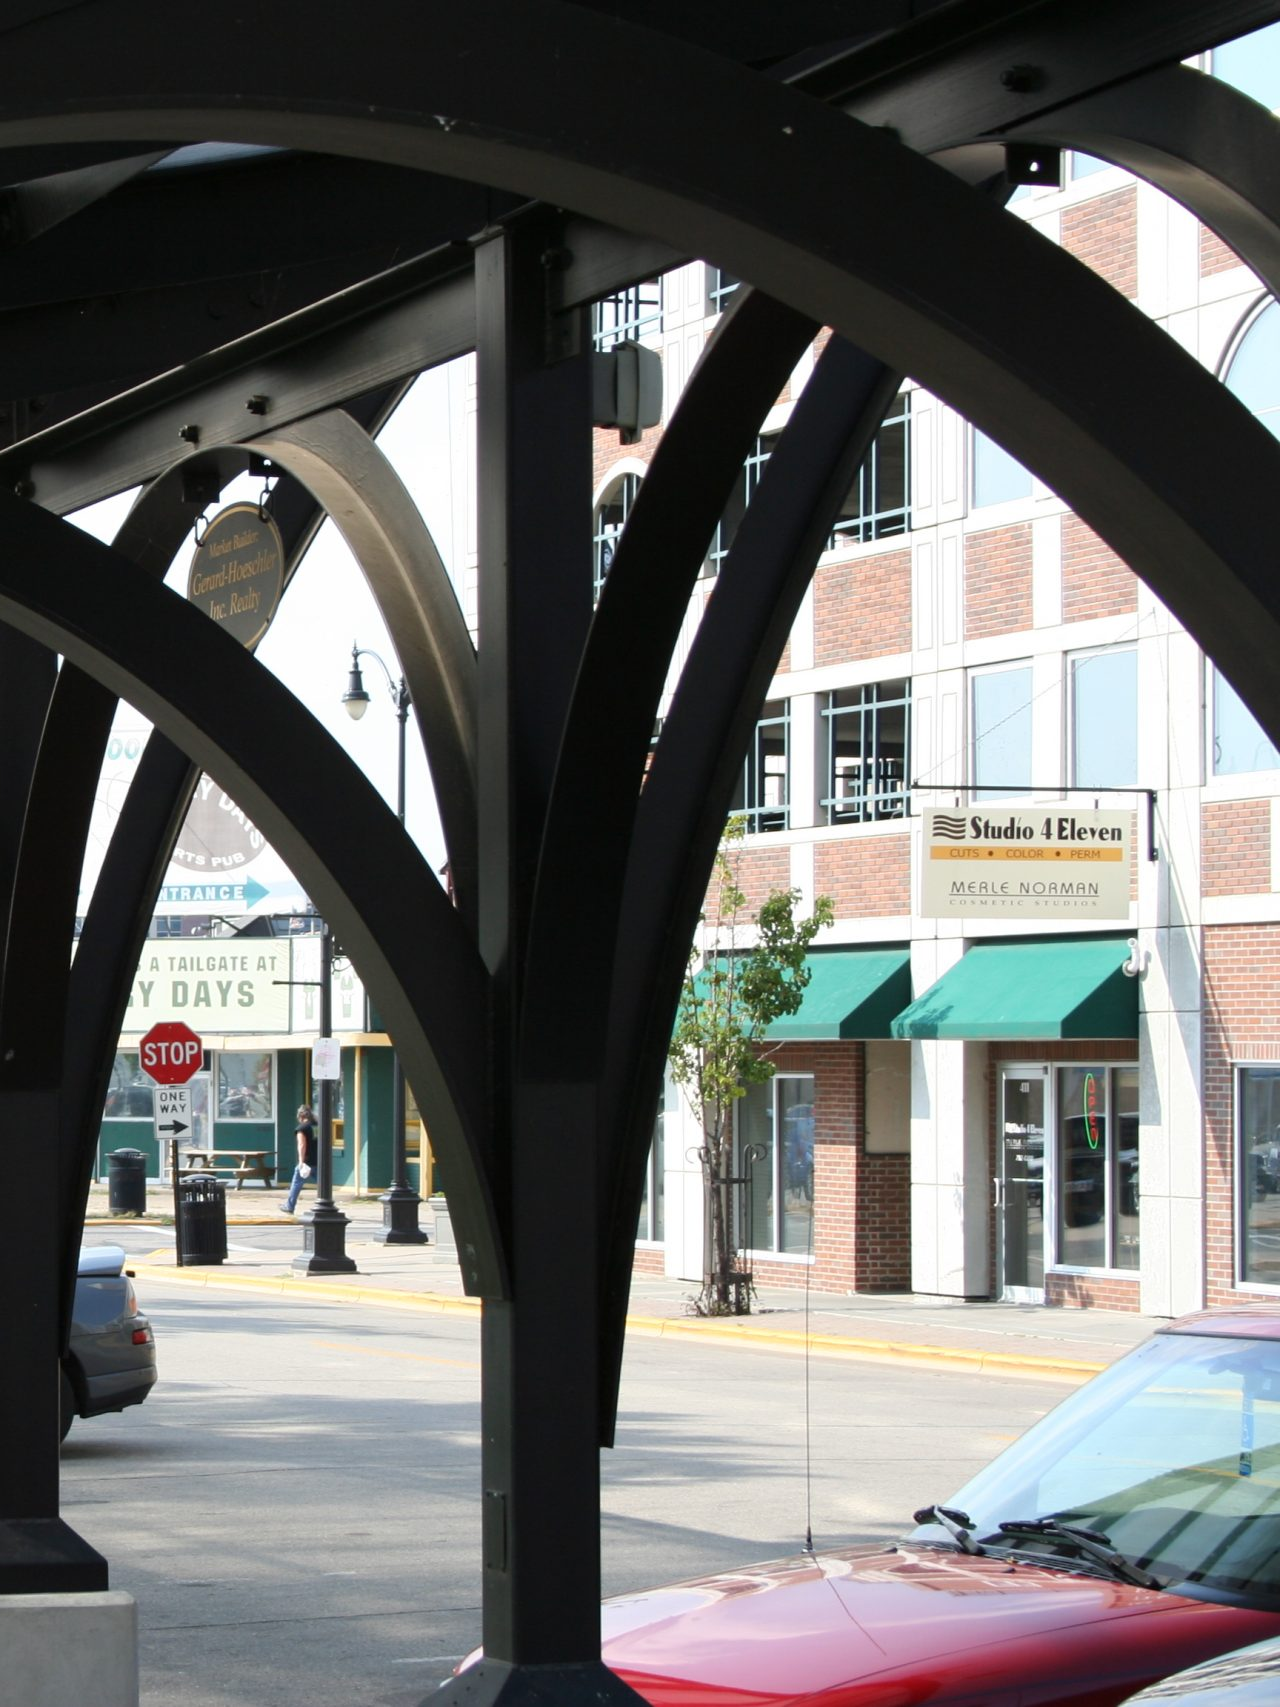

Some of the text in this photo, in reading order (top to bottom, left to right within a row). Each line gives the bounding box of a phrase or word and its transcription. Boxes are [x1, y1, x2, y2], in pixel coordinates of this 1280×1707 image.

[210, 586, 261, 621] Inc. Realty
[970, 815, 1122, 841] Studio 4 Eleven
[211, 852, 246, 868] PUB
[949, 848, 1101, 859] CUTS COLOR PERM
[160, 885, 244, 900] NTRANCE
[950, 881, 1099, 895] MERLE NORMAN
[150, 957, 160, 971] A
[168, 956, 248, 972] TAILGATE
[256, 956, 277, 972] AT
[171, 981, 255, 1008] DAYS
[144, 1041, 198, 1067] STOP
[160, 1092, 186, 1102] ONE
[160, 1104, 186, 1113] WAY
